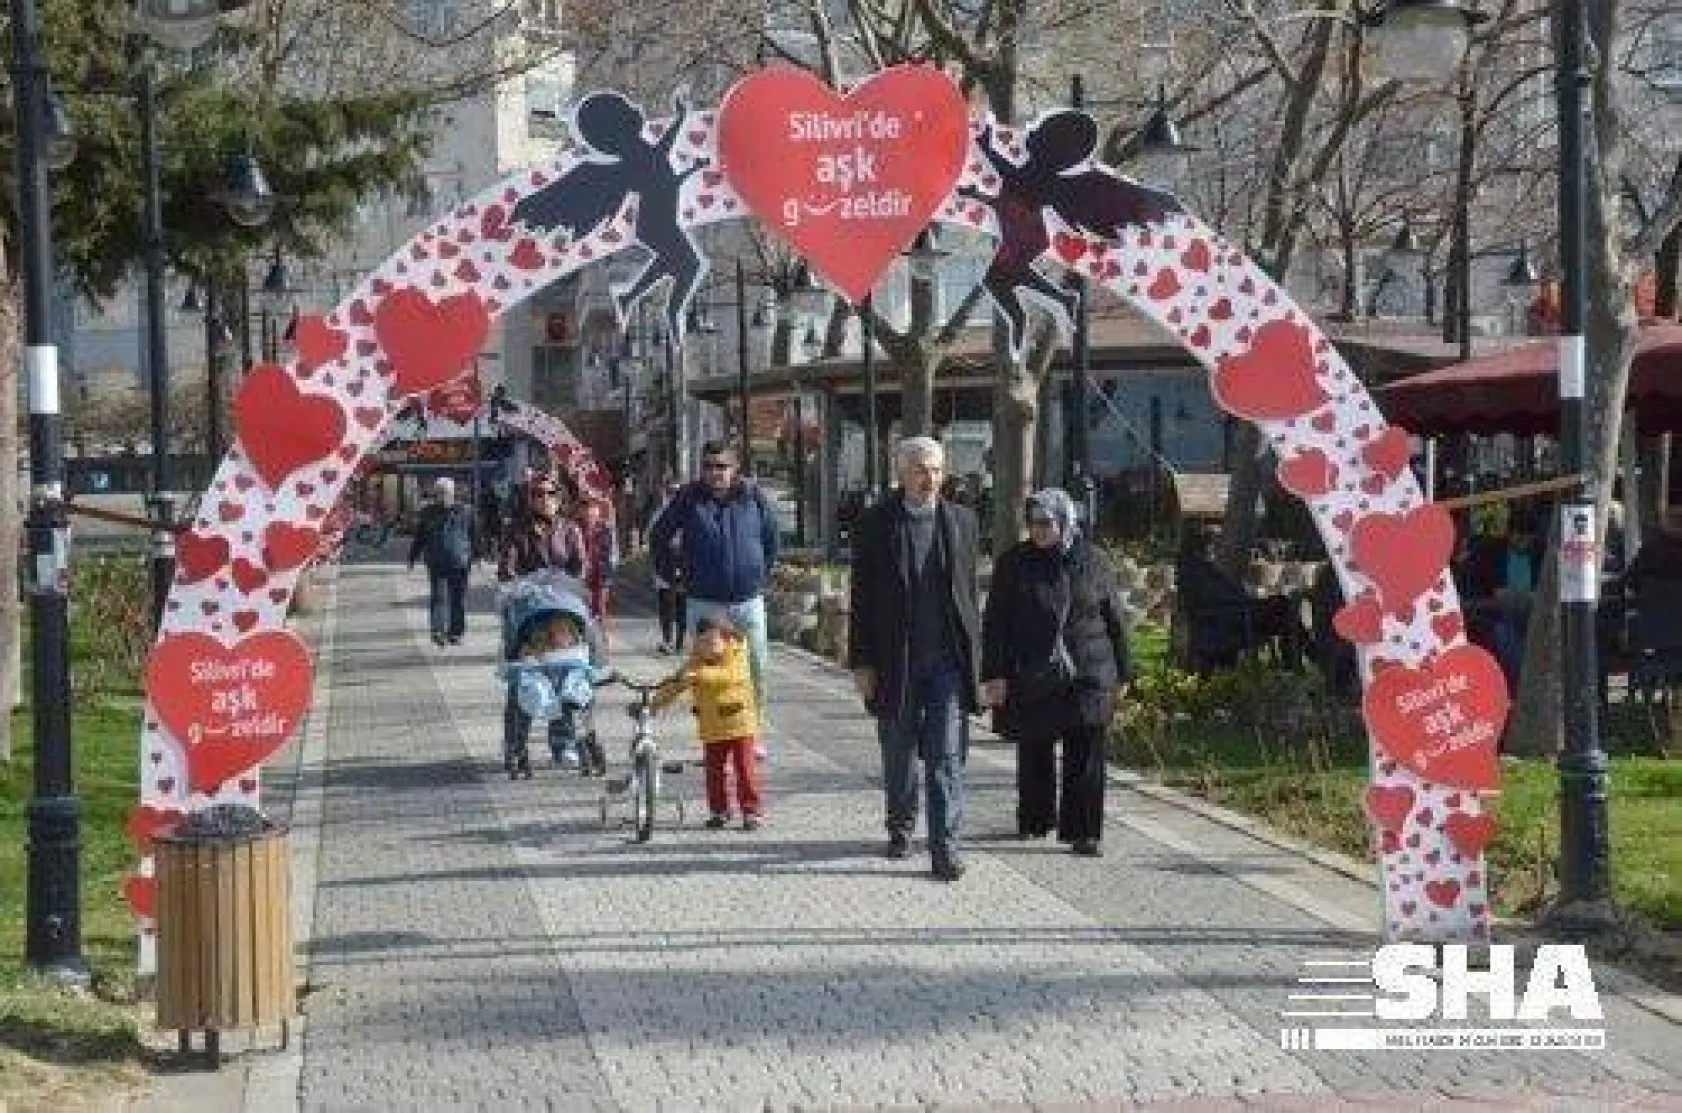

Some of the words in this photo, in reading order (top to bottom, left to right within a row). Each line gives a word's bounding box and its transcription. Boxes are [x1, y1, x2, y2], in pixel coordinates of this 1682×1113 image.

[789, 110, 901, 140] Silivri'de
[815, 147, 877, 193] aşk
[211, 682, 258, 718] aşk
